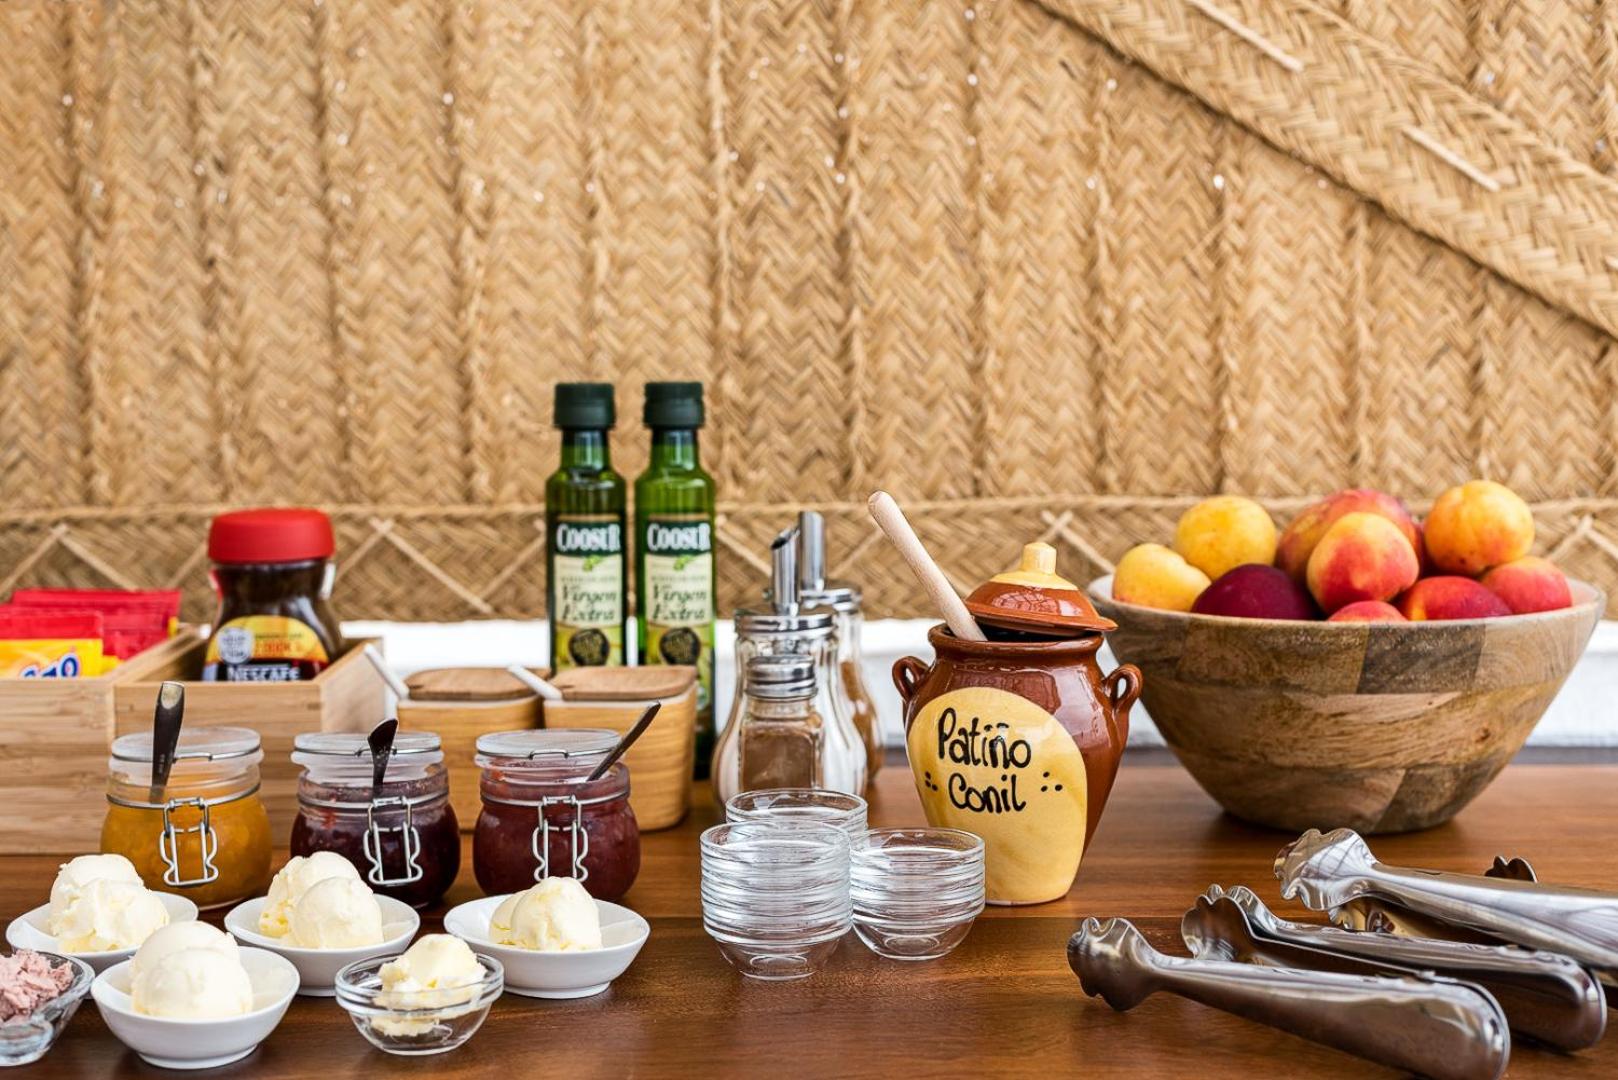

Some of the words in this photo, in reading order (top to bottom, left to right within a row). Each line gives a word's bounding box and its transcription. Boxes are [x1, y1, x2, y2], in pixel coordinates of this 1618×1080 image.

[562, 584, 617, 603] Virgen
[653, 584, 707, 603] Virgen
[562, 604, 615, 621] Extra
[652, 604, 705, 621] Extra
[938, 707, 1032, 769] Patiño
[948, 773, 1026, 813] Conil
